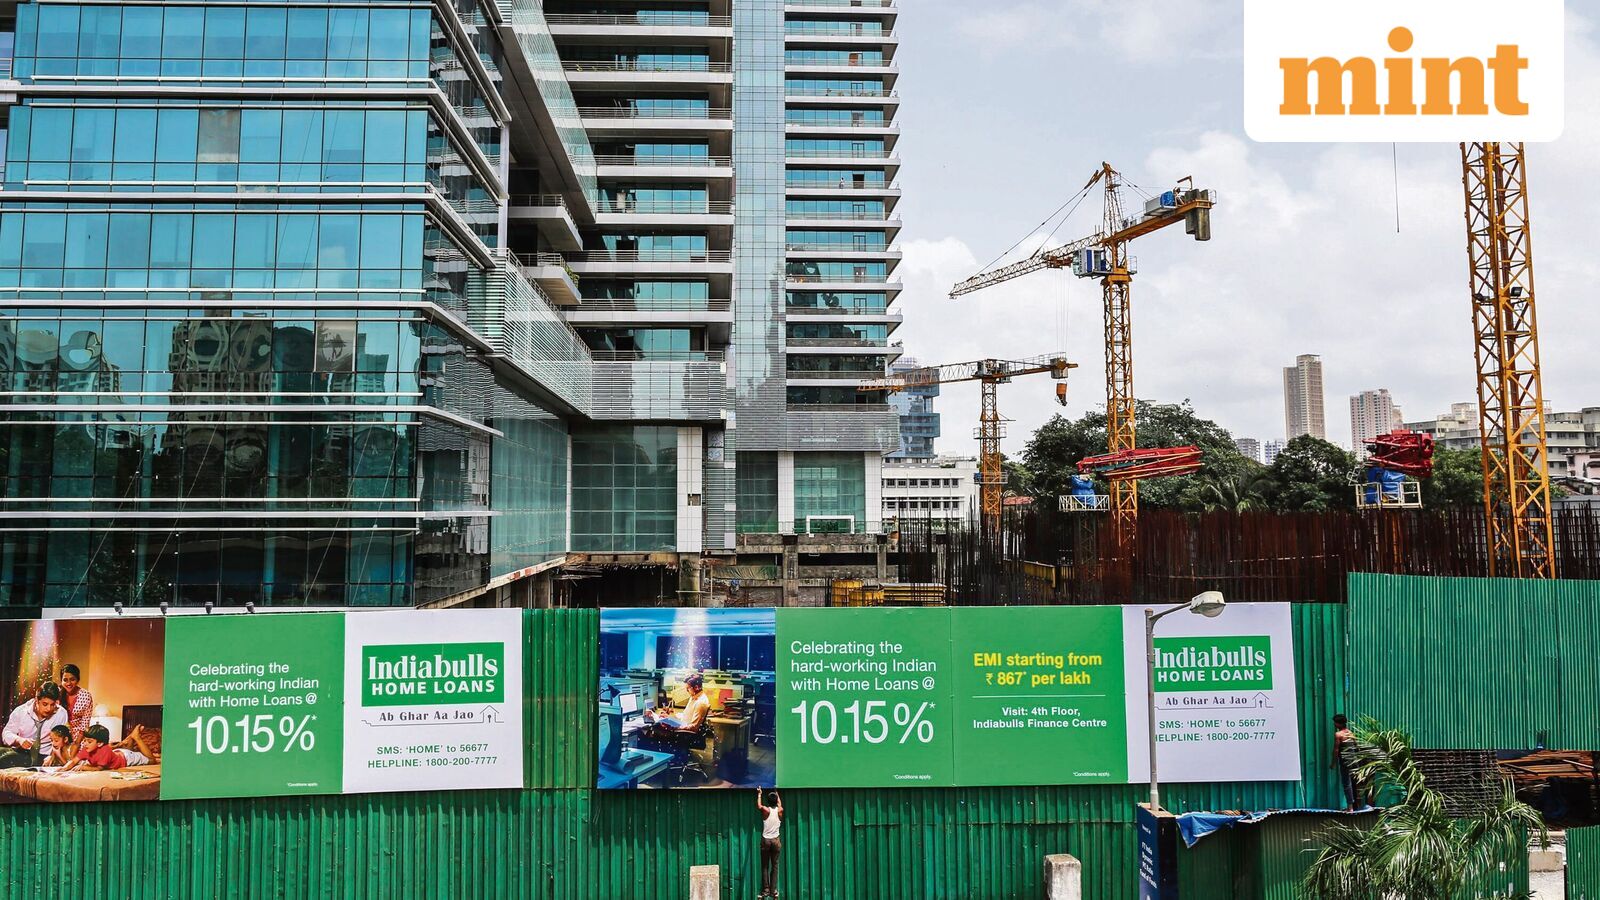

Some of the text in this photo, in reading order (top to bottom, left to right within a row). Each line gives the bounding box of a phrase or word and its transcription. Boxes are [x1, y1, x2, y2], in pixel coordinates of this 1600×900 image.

[791, 641, 902, 656] Celebrating the
[974, 652, 1102, 668] EMI starting from
[1154, 646, 1266, 668] Indiabulls
[190, 662, 289, 676] Celebrating the
[368, 654, 499, 680] Indiabulls
[792, 659, 936, 675] hard-working Indian
[986, 672, 993, 685] ₹
[1032, 675, 1056, 687] per
[1060, 671, 1091, 684] lakh
[1158, 669, 1264, 682] HOME LOANS
[190, 677, 319, 692] hard-working Indian
[372, 680, 494, 695] HOME LOANS
[791, 677, 935, 690] with Home Loans @
[189, 693, 317, 708] with Home Loans @
[1165, 696, 1248, 706] Ab Ghar Aa Jao
[379, 710, 474, 722] Ab Ghar Aa Jao
[1001, 706, 1081, 717] Visit: 4th Floor,
[973, 718, 1107, 729] Indiabulls Finance Centre
[1158, 720, 1184, 729] SMS:
[1225, 719, 1236, 728] to
[1238, 718, 1266, 728] 56677
[1206, 731, 1276, 741] 1800-200-7777
[376, 745, 403, 755] SMS:
[446, 745, 457, 753] to
[459, 743, 489, 753] 56677
[367, 756, 498, 769] HELPLINE: 1800-200-7777
